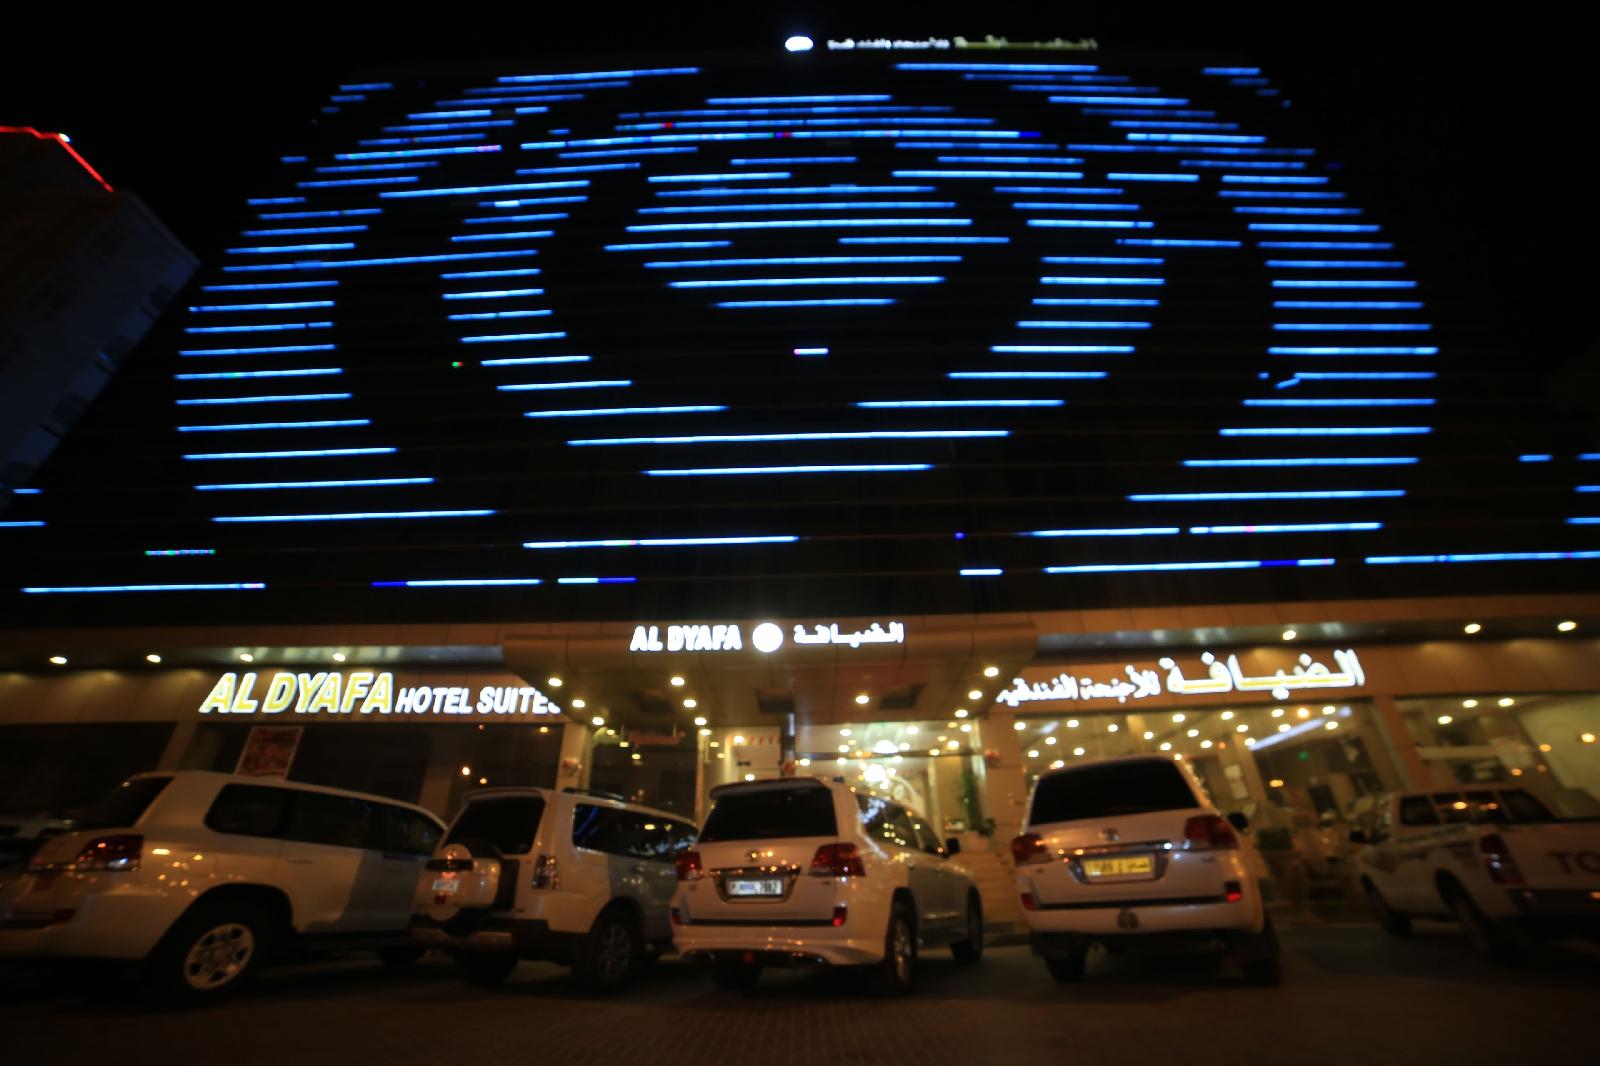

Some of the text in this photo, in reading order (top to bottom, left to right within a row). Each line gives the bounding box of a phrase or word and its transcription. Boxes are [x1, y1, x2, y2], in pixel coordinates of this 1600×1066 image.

[629, 624, 742, 651] AL DYAFA
[793, 622, 904, 648] الضيافة
[1158, 649, 1365, 700] الضيافة
[198, 672, 257, 713] AL
[261, 672, 394, 713] DYAFA
[395, 687, 473, 713] HOTEL
